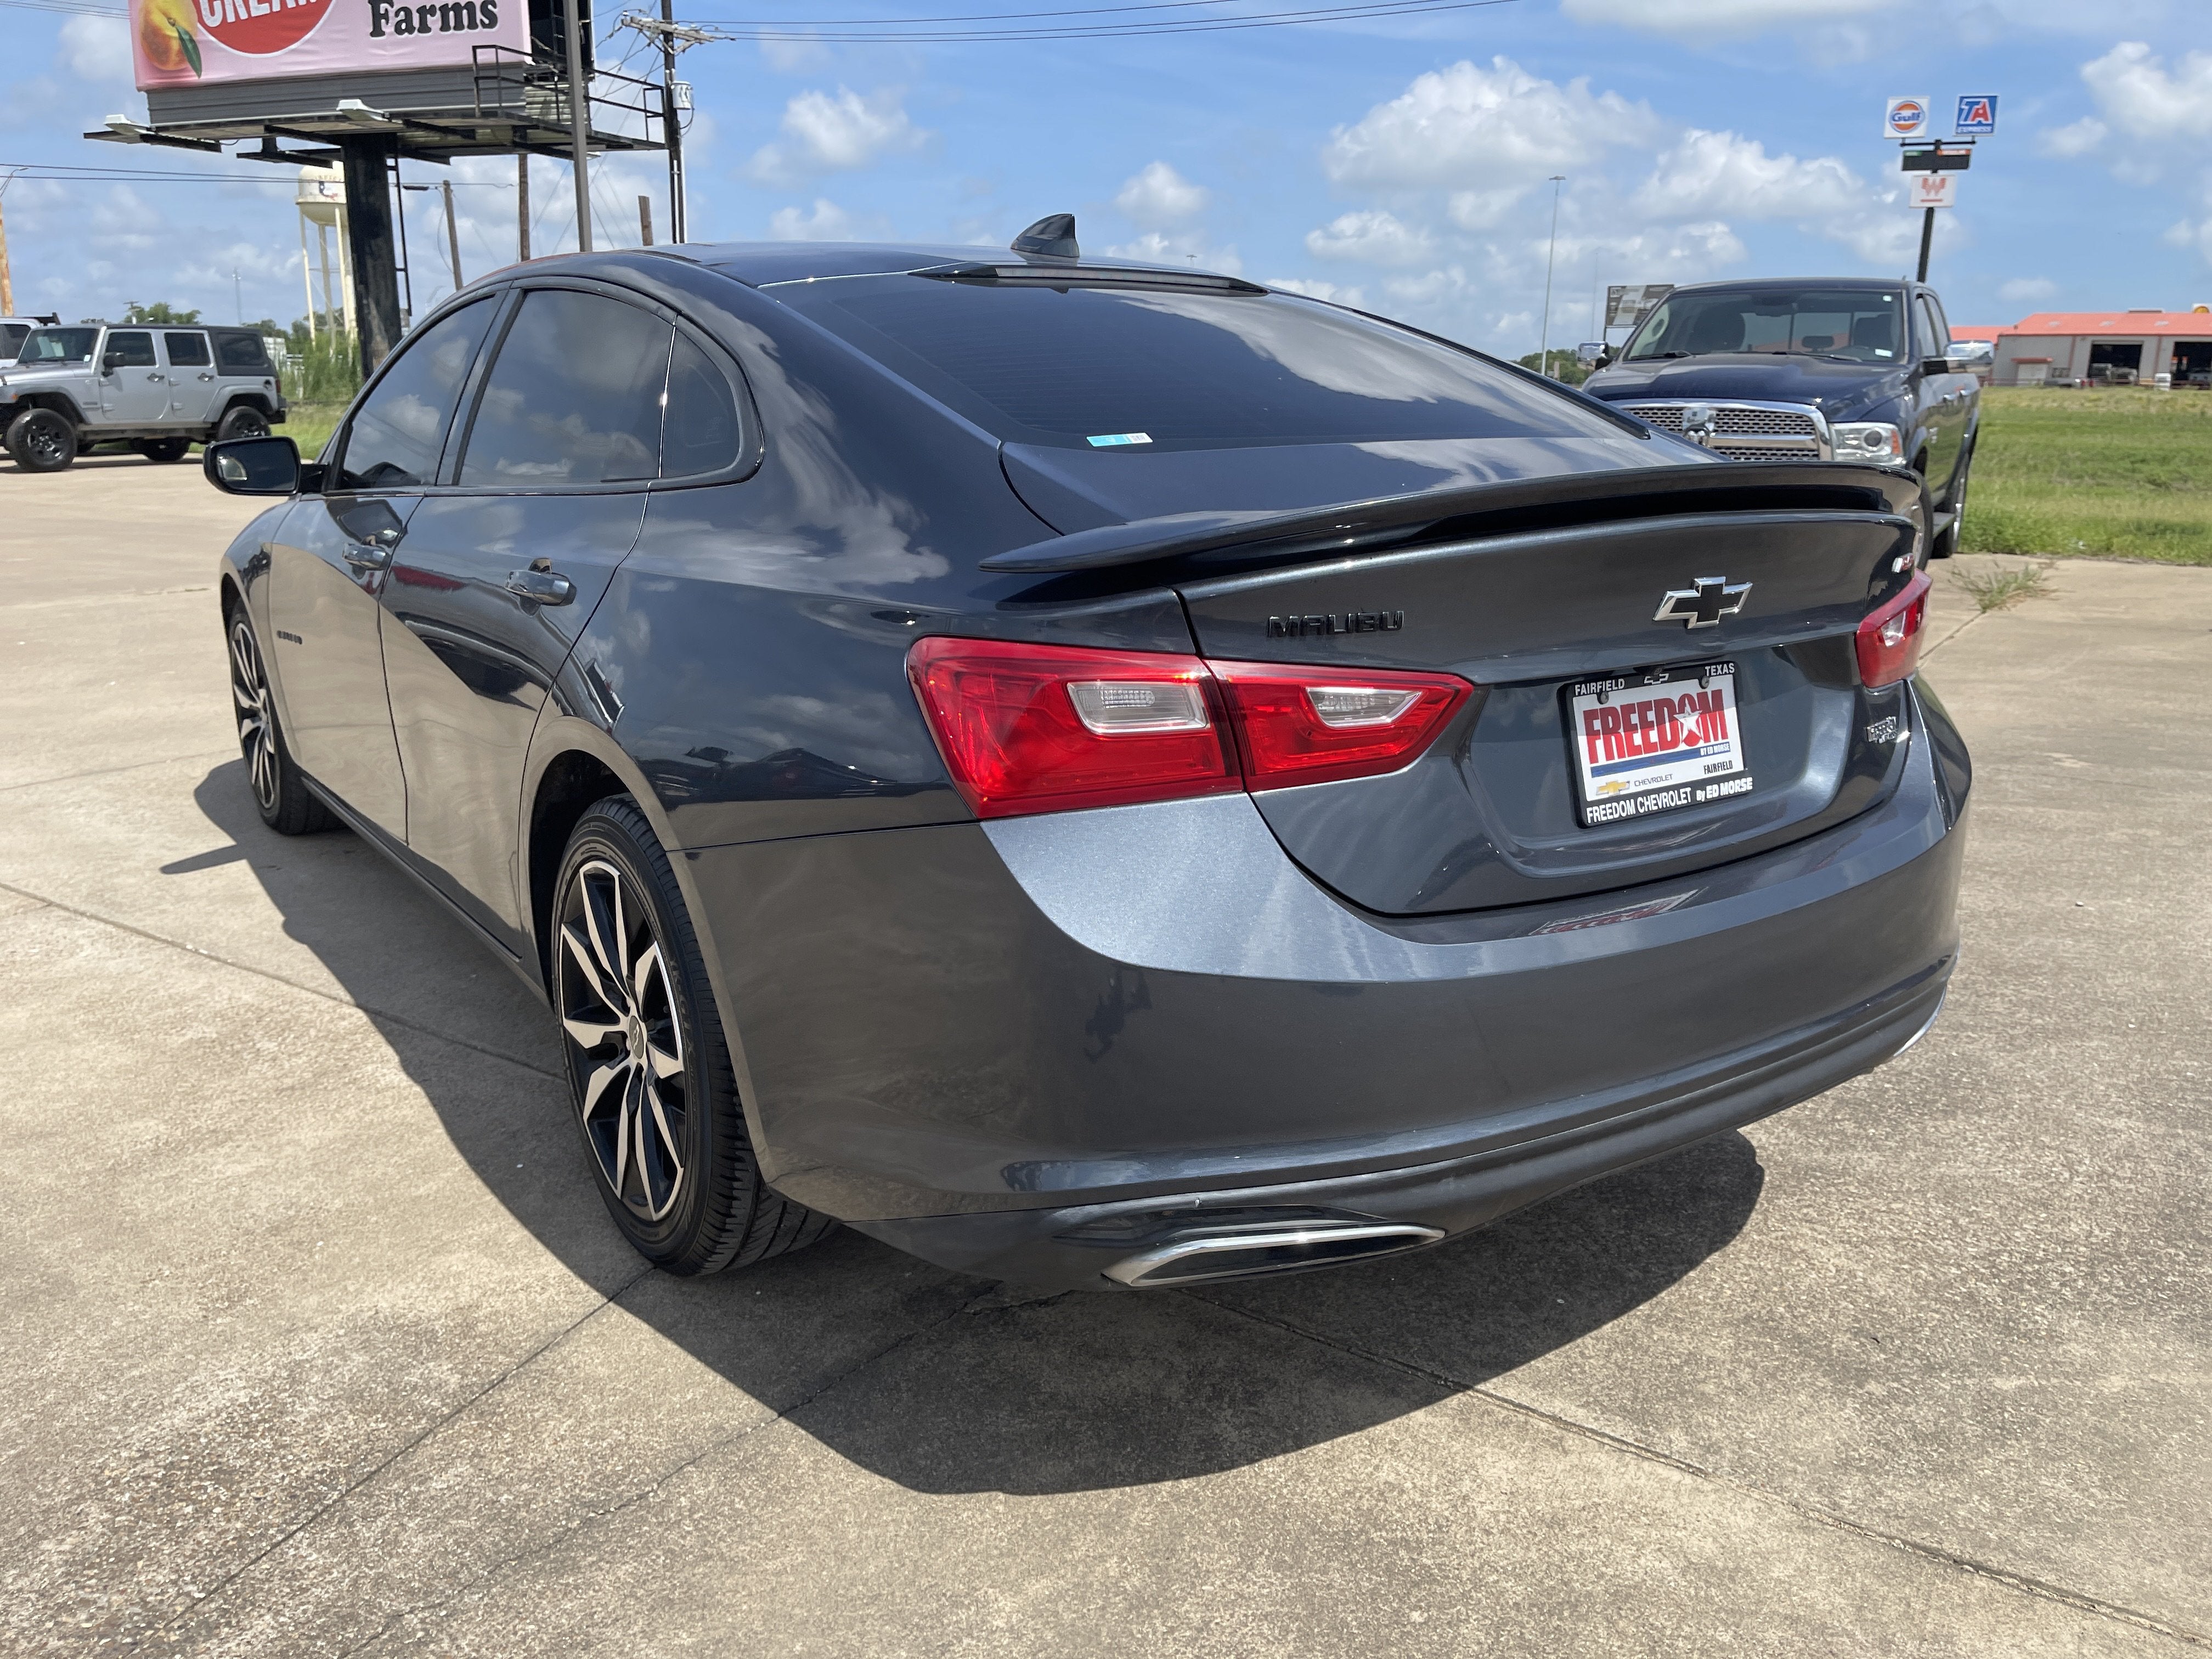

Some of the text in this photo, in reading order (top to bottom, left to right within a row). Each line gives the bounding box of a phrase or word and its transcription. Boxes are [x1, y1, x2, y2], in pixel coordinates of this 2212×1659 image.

[368, 0, 498, 37] Farms
[1892, 112, 1921, 122] Gulf
[1959, 99, 1993, 124] TA
[1267, 611, 1404, 637] MALIBU
[1705, 663, 1735, 676] TEXAS
[1575, 679, 1625, 696] FAIRFIELD
[1583, 689, 1729, 764] FREEDOM
[1700, 743, 1730, 756] BY ED MORSE
[1703, 760, 1733, 775] FAIRFIELD
[1634, 774, 1673, 787] CHEVROLET
[1586, 777, 1753, 823] FREEDOM CHEVROLET By ED MORSE
